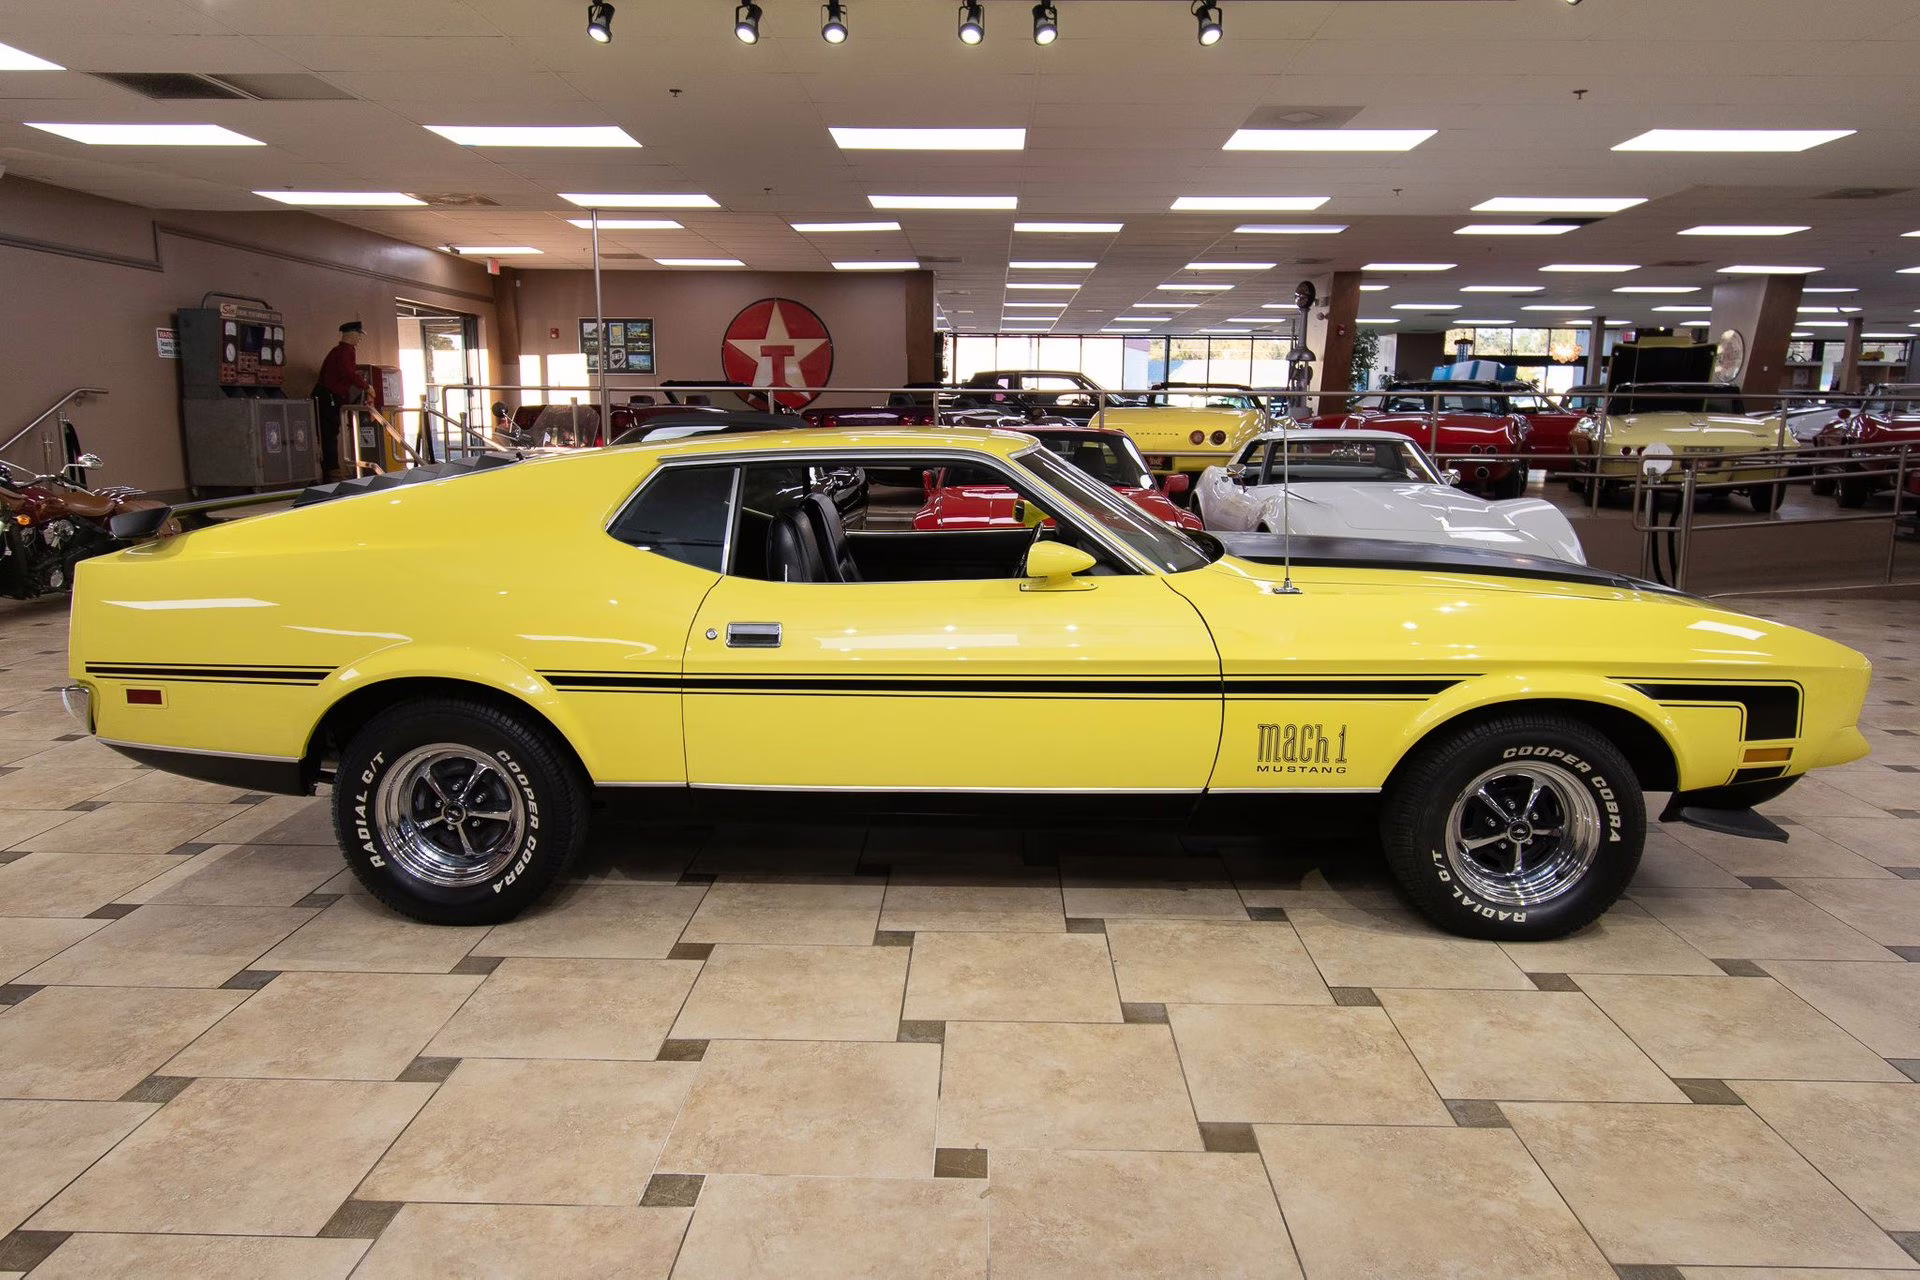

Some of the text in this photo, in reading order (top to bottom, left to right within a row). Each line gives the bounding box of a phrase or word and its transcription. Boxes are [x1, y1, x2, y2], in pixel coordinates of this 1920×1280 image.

[760, 345, 795, 388] T
[1256, 765, 1347, 774] MUSTANG
[1335, 724, 1347, 764] 1
[355, 751, 386, 868] RADIAL G/T
[492, 750, 539, 894] COOPER COBRA
[1503, 746, 1621, 843] COOPER COBRA
[1432, 850, 1527, 923] RADIAL G/T
